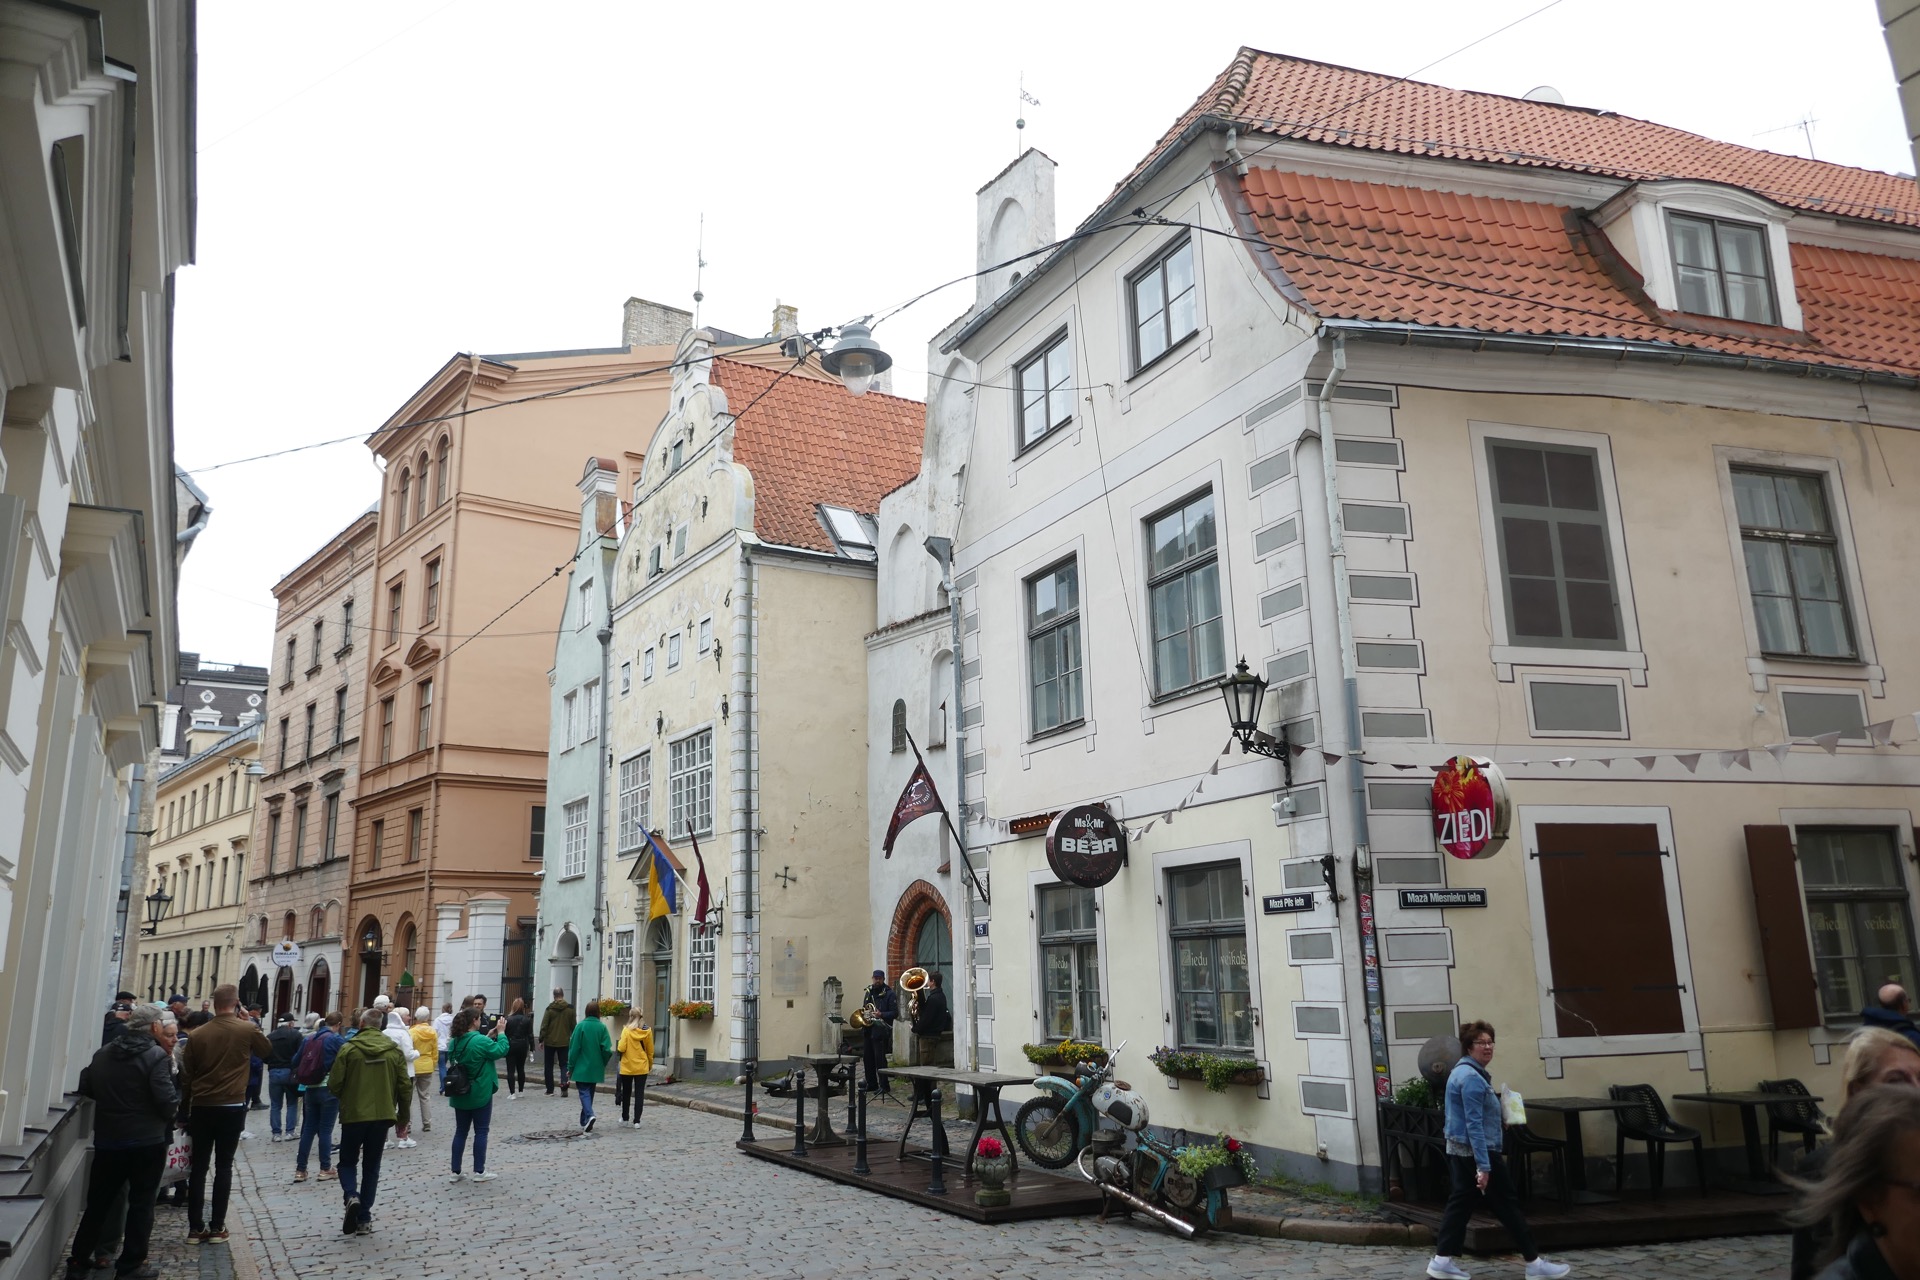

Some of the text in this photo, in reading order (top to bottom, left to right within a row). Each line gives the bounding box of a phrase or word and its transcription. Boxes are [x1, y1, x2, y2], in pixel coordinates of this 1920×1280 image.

[1438, 807, 1492, 844] ZIEDI
[1061, 837, 1118, 855] BEER
[1284, 898, 1294, 907] Pils
[1294, 896, 1304, 907] iela
[1467, 892, 1482, 902] iela
[977, 925, 984, 935] 15
